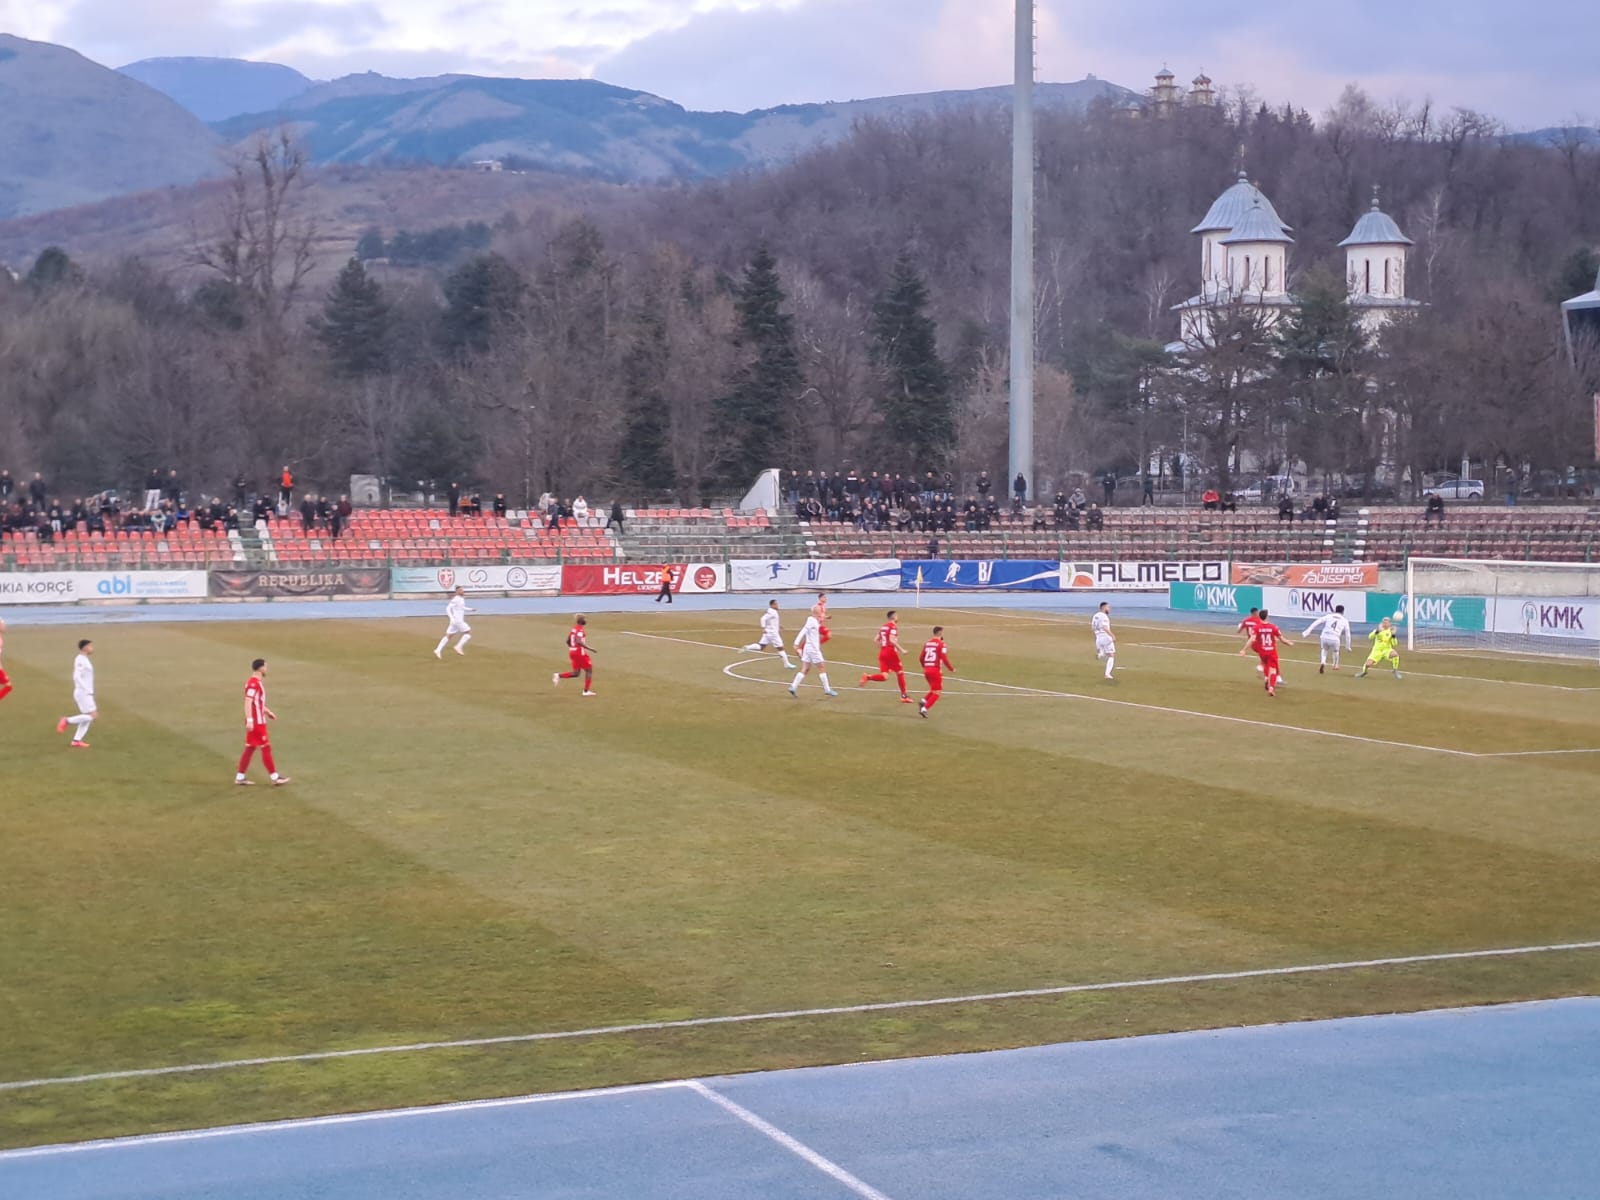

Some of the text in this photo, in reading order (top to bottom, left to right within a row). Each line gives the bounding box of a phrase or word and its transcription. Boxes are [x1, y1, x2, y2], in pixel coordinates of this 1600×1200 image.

[258, 574, 345, 586] REPUBLIKA
[1098, 563, 1221, 582] ALMECO
[0, 580, 73, 595] KIA KORÇE
[97, 575, 132, 594] abi
[1207, 587, 1237, 607] KMK
[1301, 592, 1336, 612] KMK
[1414, 598, 1453, 621] KMK
[1540, 604, 1584, 630] KMK
[1331, 620, 1338, 631] 4
[1261, 633, 1272, 647] 14
[924, 647, 936, 662] 25
